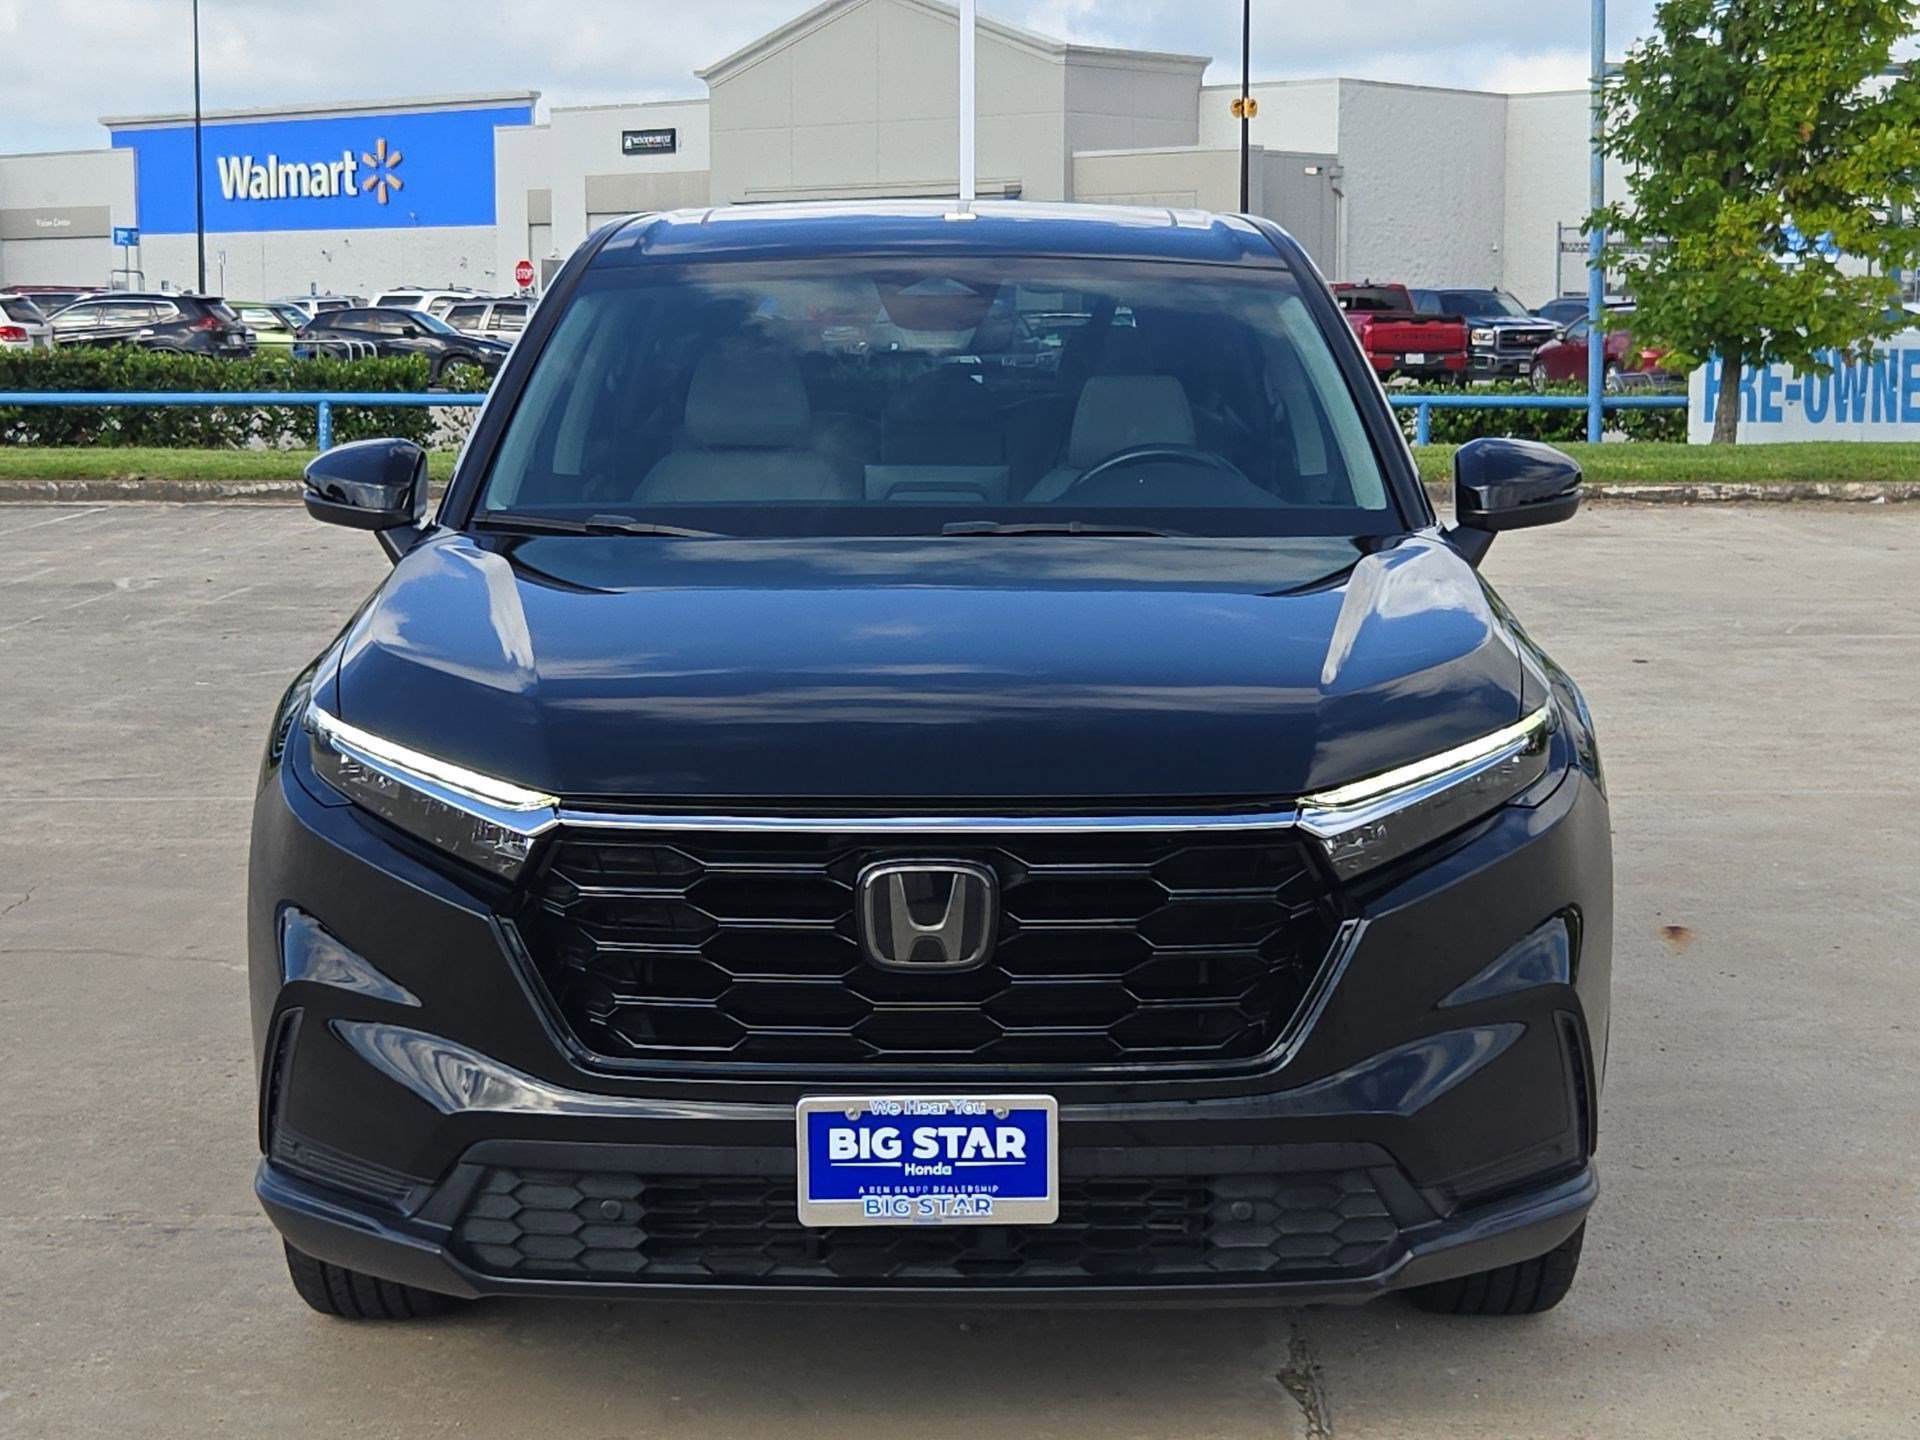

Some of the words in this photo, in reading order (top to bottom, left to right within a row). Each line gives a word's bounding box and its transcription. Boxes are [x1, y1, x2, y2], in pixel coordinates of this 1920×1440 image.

[217, 151, 358, 201] Walmart
[517, 268, 533, 280] STOP
[869, 1099, 901, 1116] We
[903, 1099, 948, 1116] Hear
[950, 1099, 987, 1116] You
[829, 1127, 902, 1160] BIG
[912, 1127, 1026, 1159] STAR
[904, 1162, 952, 1177] Honda
[933, 1185, 999, 1194] DEALERSHIP
[863, 1197, 911, 1216] BIG
[917, 1196, 993, 1215] STAR
